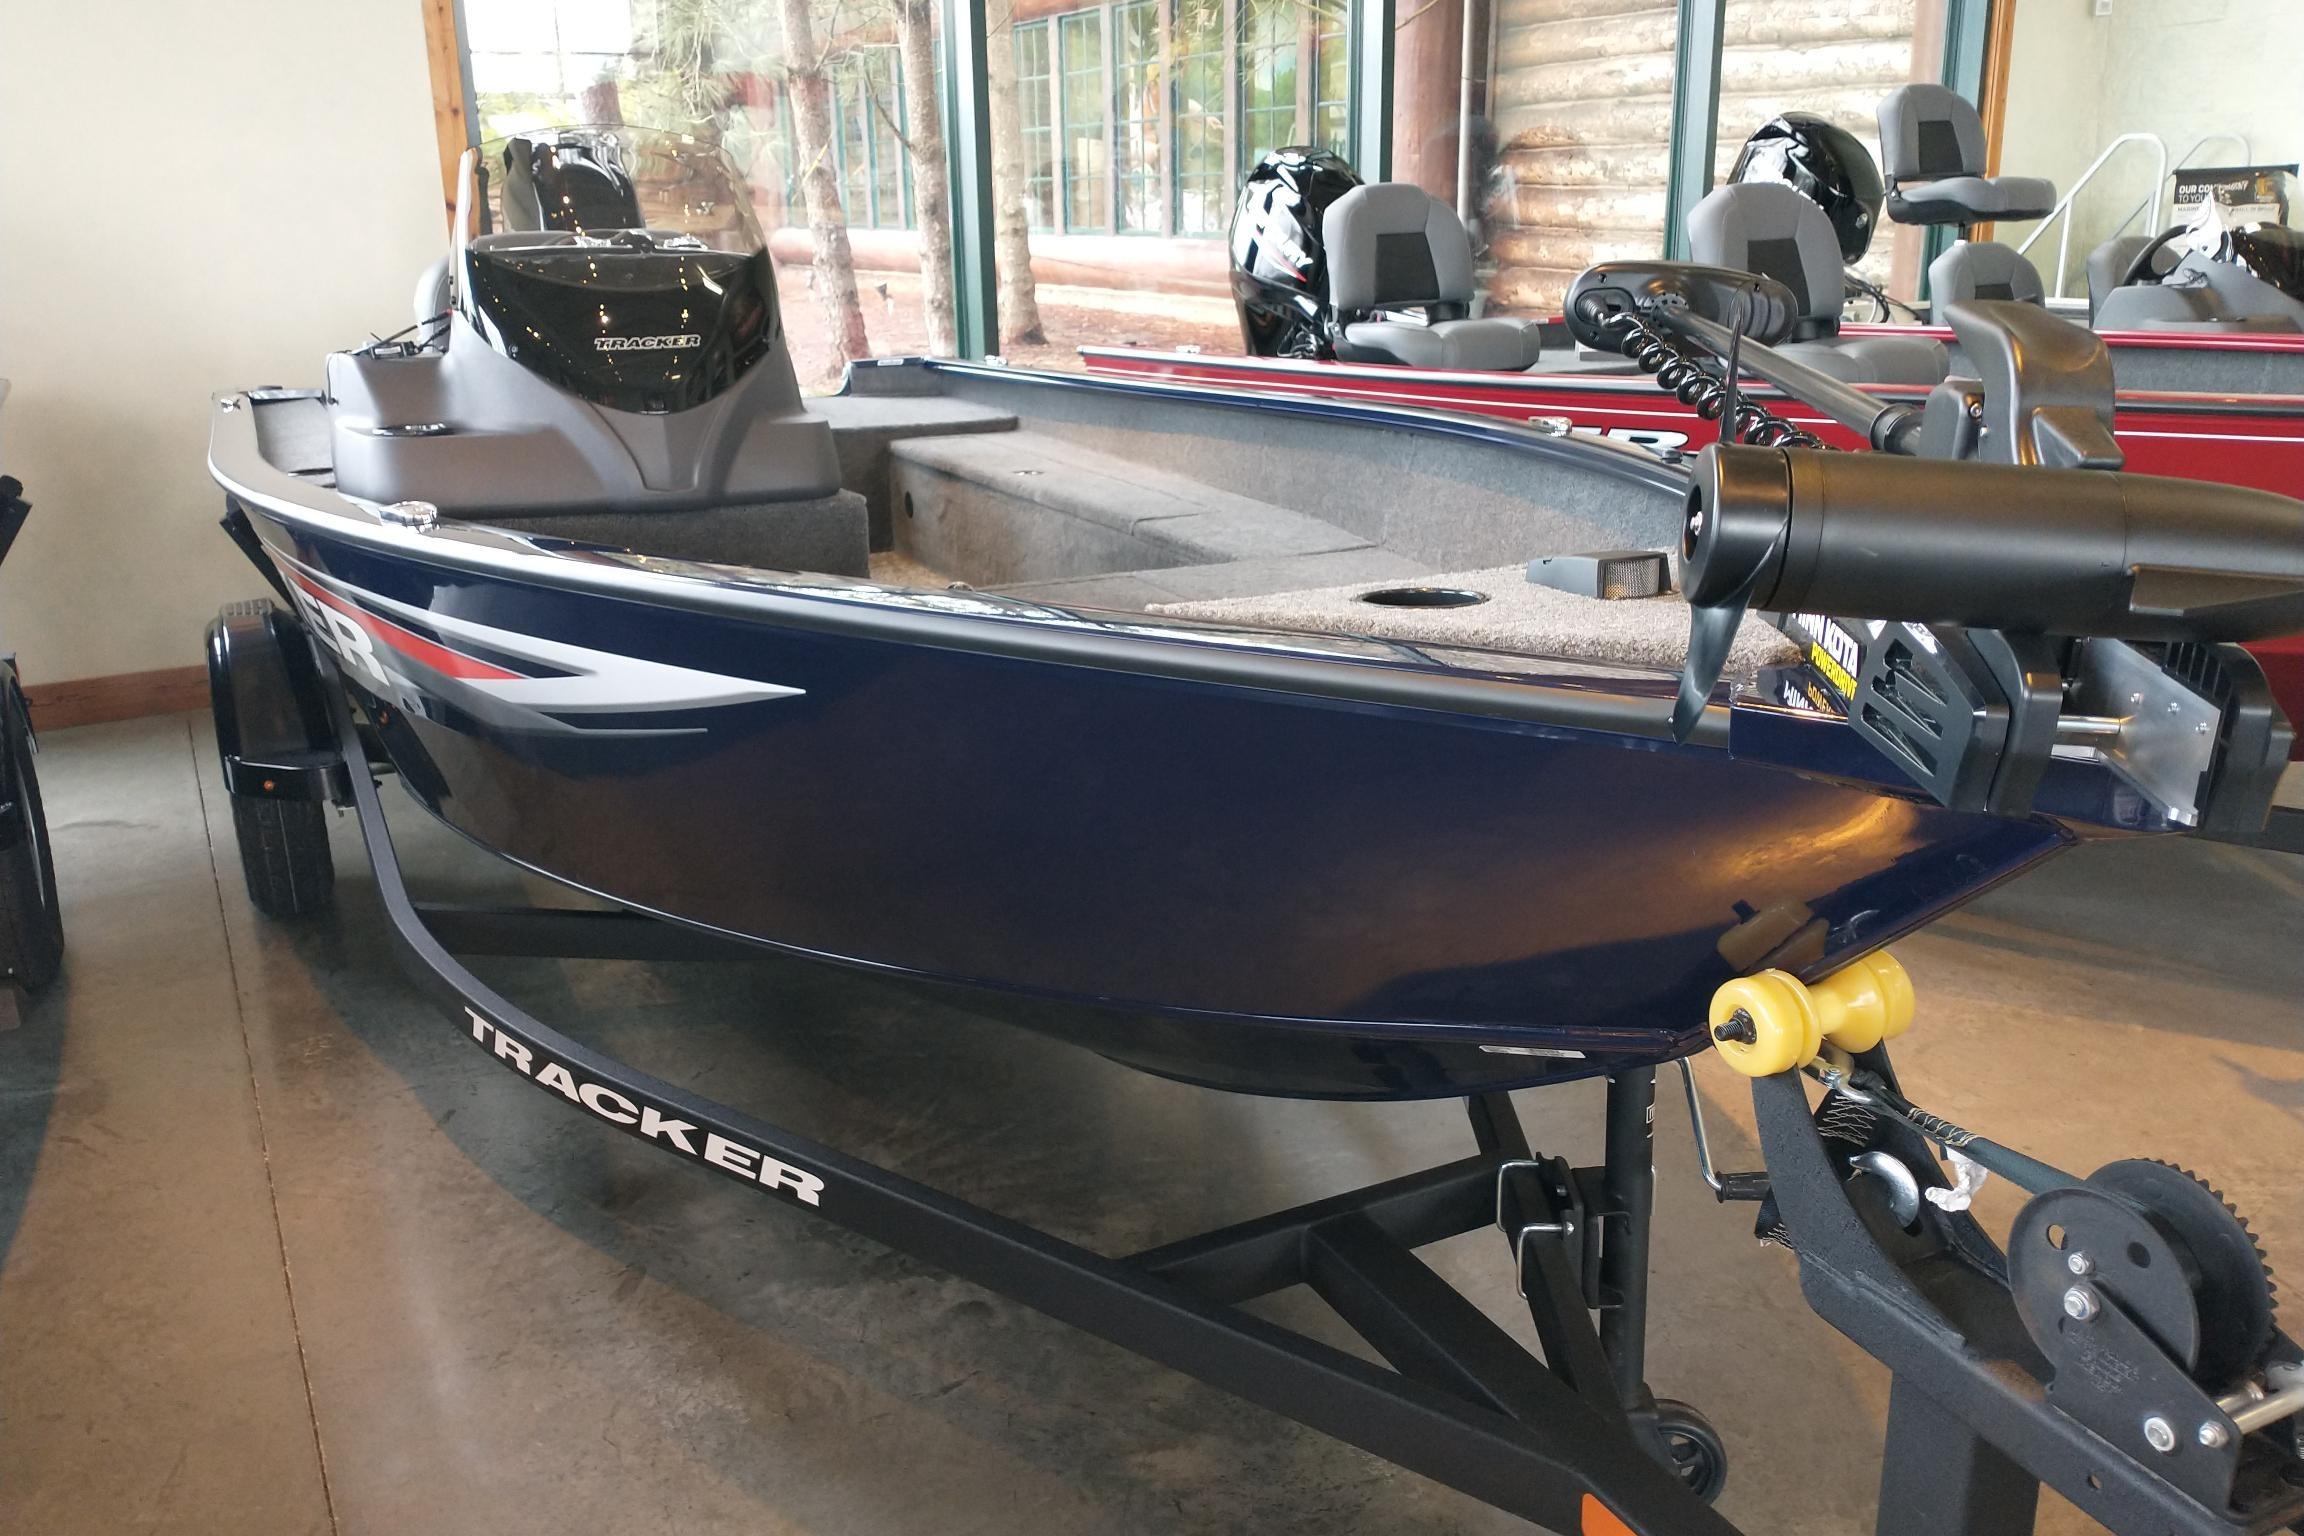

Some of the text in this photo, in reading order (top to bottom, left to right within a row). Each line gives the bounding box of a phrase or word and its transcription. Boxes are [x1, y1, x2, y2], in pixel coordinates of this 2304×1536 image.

[2179, 184, 2196, 194] OUR
[2178, 194, 2189, 203] TO
[594, 334, 700, 350] TRACKER
[1823, 618, 1859, 678] KOTA
[464, 1006, 825, 1207] TRACKER
